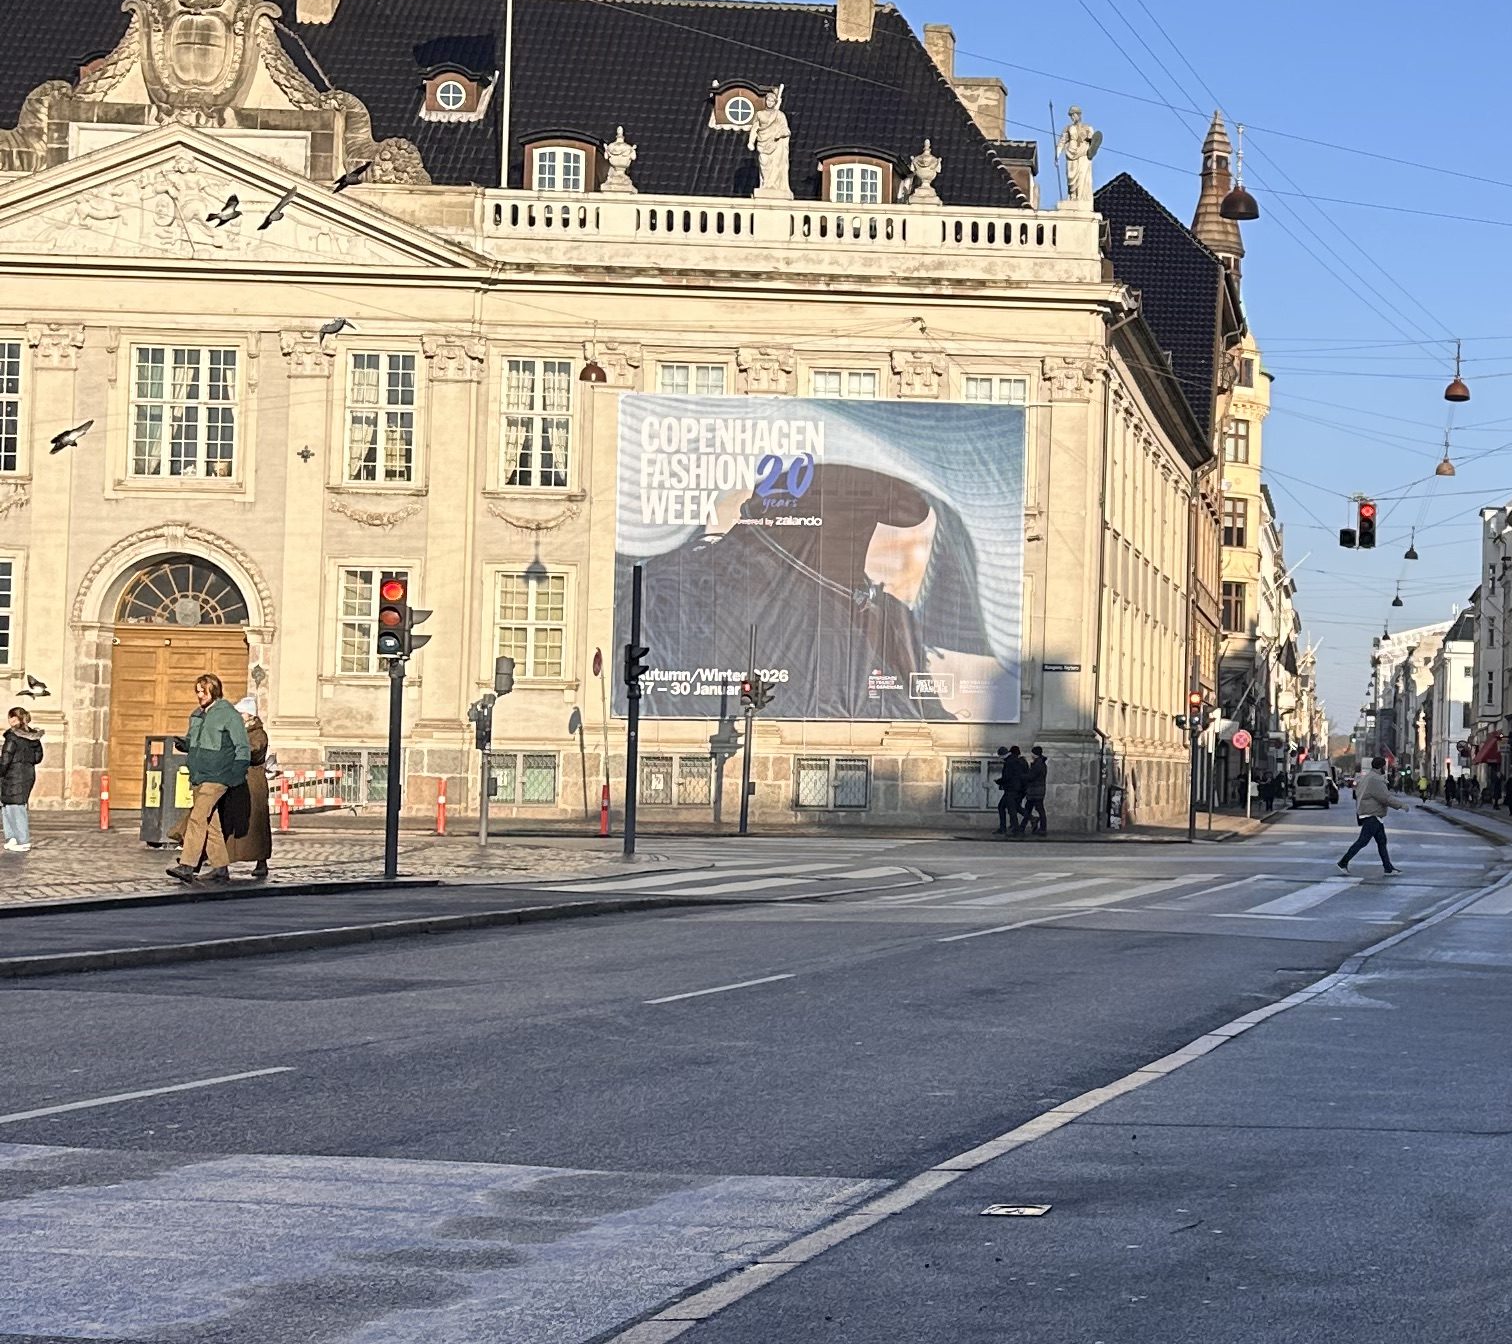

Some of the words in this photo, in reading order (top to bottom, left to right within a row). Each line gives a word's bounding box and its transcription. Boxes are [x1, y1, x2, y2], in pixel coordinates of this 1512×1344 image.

[640, 416, 825, 456] COPENHAGEN
[639, 453, 756, 491] FASHION
[756, 452, 814, 498] 20
[640, 489, 719, 526] WEEK
[762, 497, 799, 514] years
[764, 516, 774, 527] by
[775, 515, 823, 527] zalando
[670, 682, 690, 695] 30
[693, 682, 740, 696] Januar
